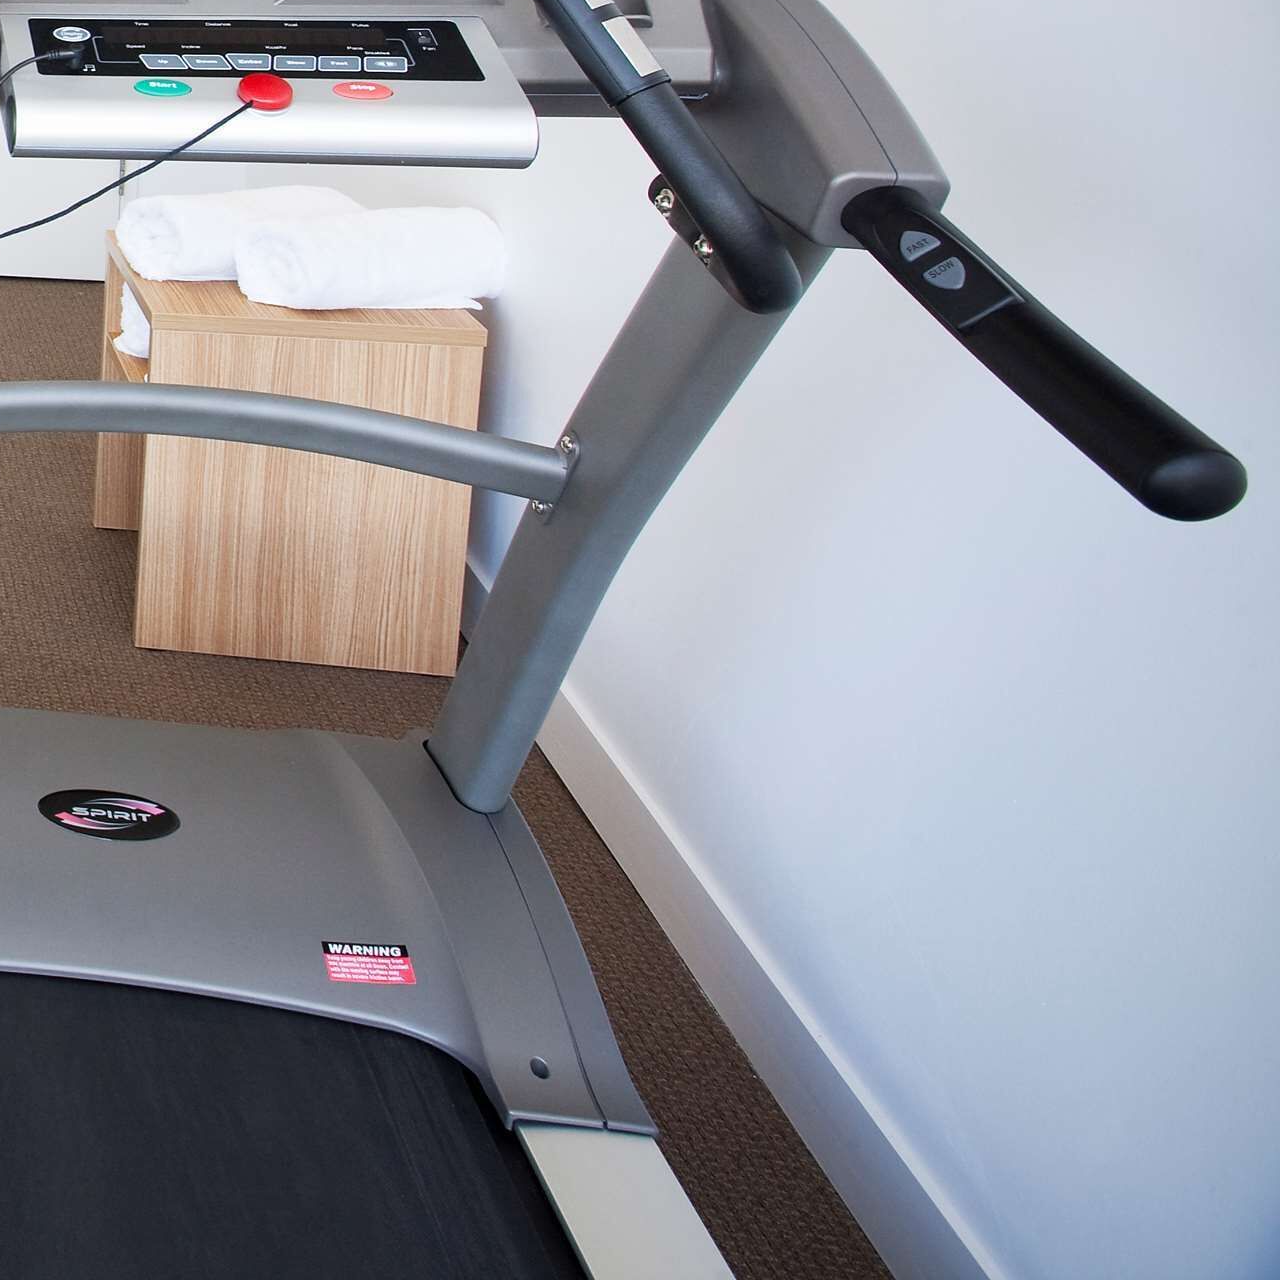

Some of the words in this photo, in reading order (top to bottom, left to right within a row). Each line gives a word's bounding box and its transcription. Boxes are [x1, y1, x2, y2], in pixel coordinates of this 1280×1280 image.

[148, 81, 178, 89] Start
[905, 238, 929, 254] FAST
[928, 260, 955, 278] SLOW
[71, 806, 152, 823] SPIRIT
[327, 942, 402, 957] WARNING
